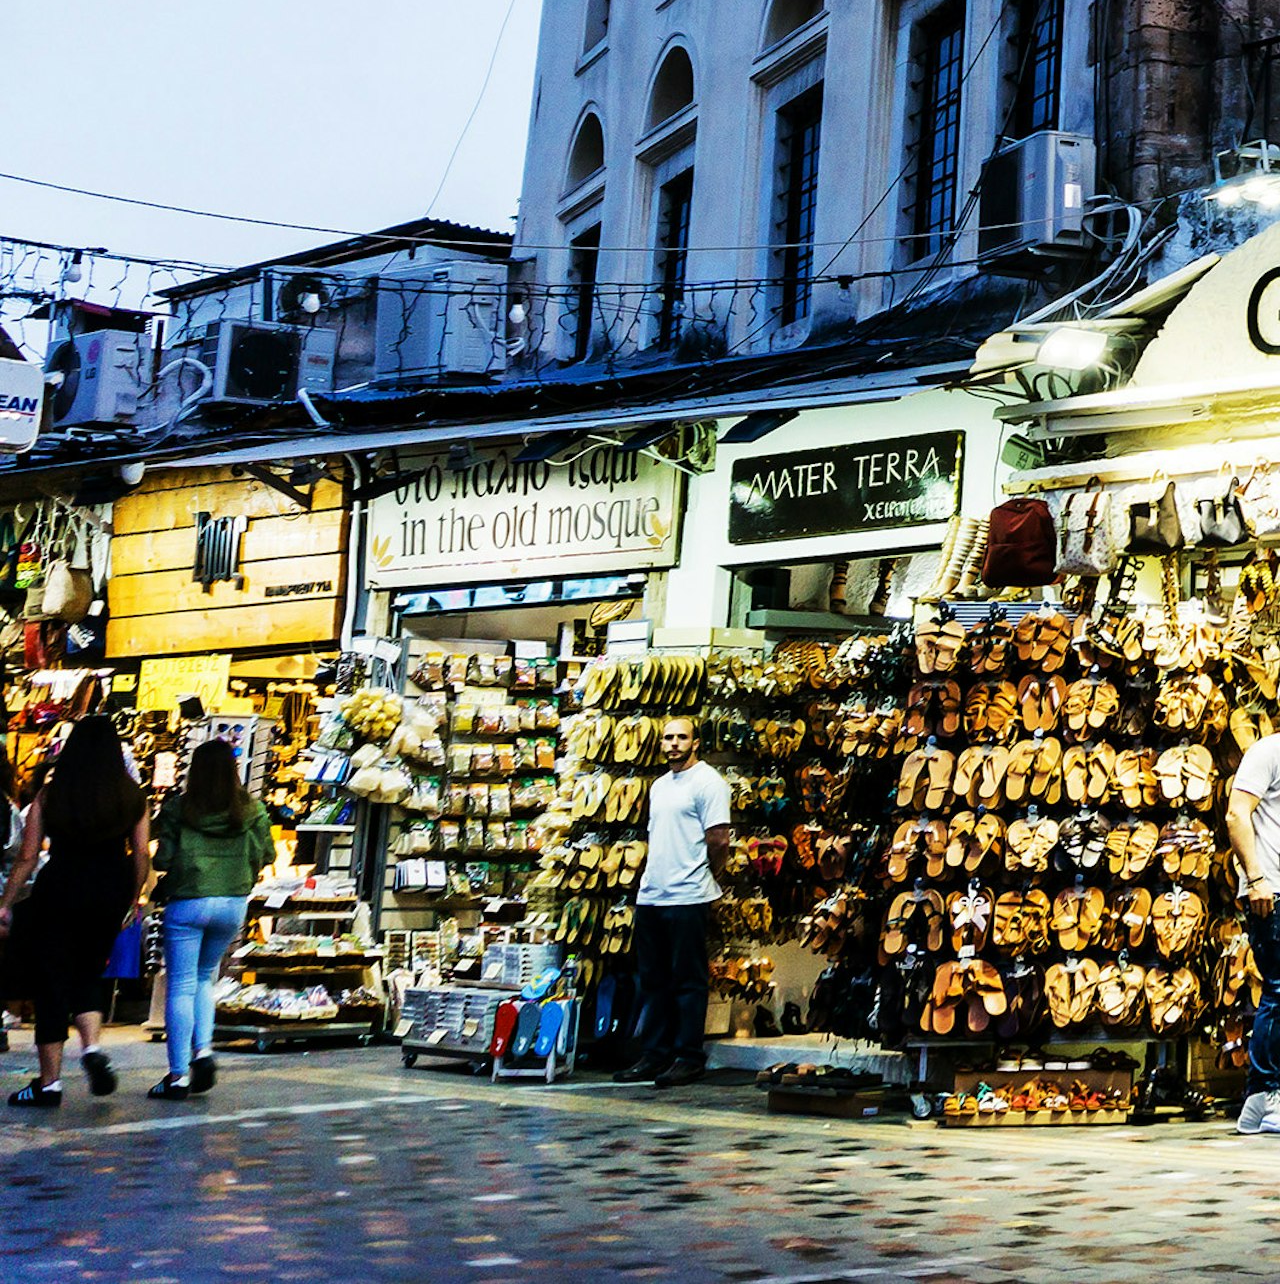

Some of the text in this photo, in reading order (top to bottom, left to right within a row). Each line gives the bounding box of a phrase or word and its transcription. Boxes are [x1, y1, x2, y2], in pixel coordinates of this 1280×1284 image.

[745, 447, 941, 505] MATER TERRA
[401, 496, 661, 557] in the old mosque
